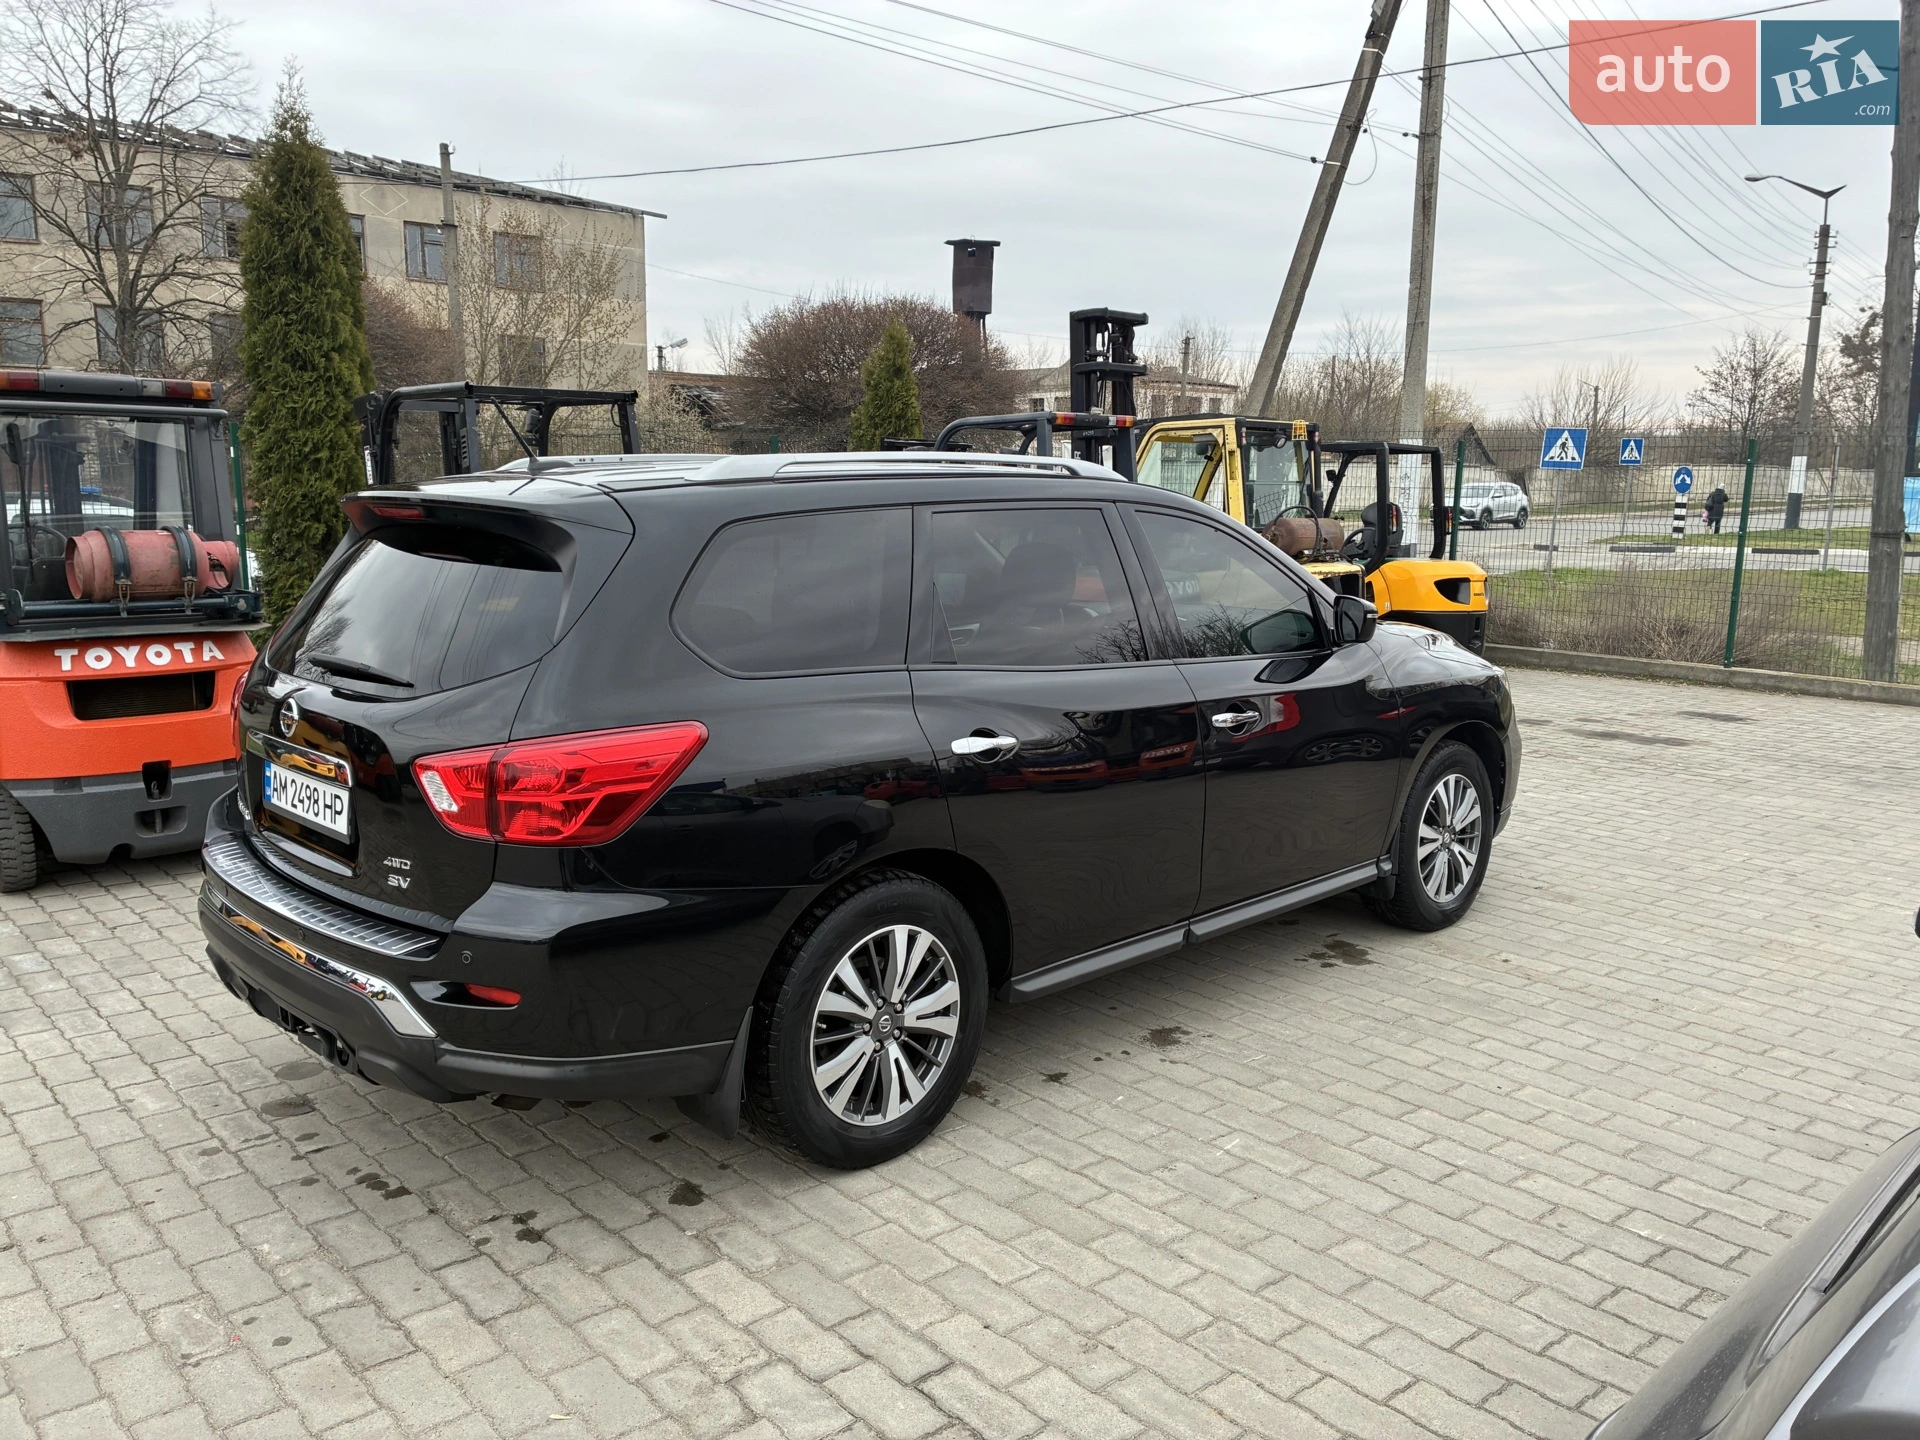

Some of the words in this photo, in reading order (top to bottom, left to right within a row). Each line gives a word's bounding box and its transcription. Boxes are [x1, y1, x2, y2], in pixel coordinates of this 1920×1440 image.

[54, 640, 225, 671] TOYOTA
[272, 770, 288, 805] AM
[290, 778, 320, 818] 2498
[323, 790, 344, 825] HP
[383, 856, 411, 870] 4WD
[387, 874, 411, 889] SV
